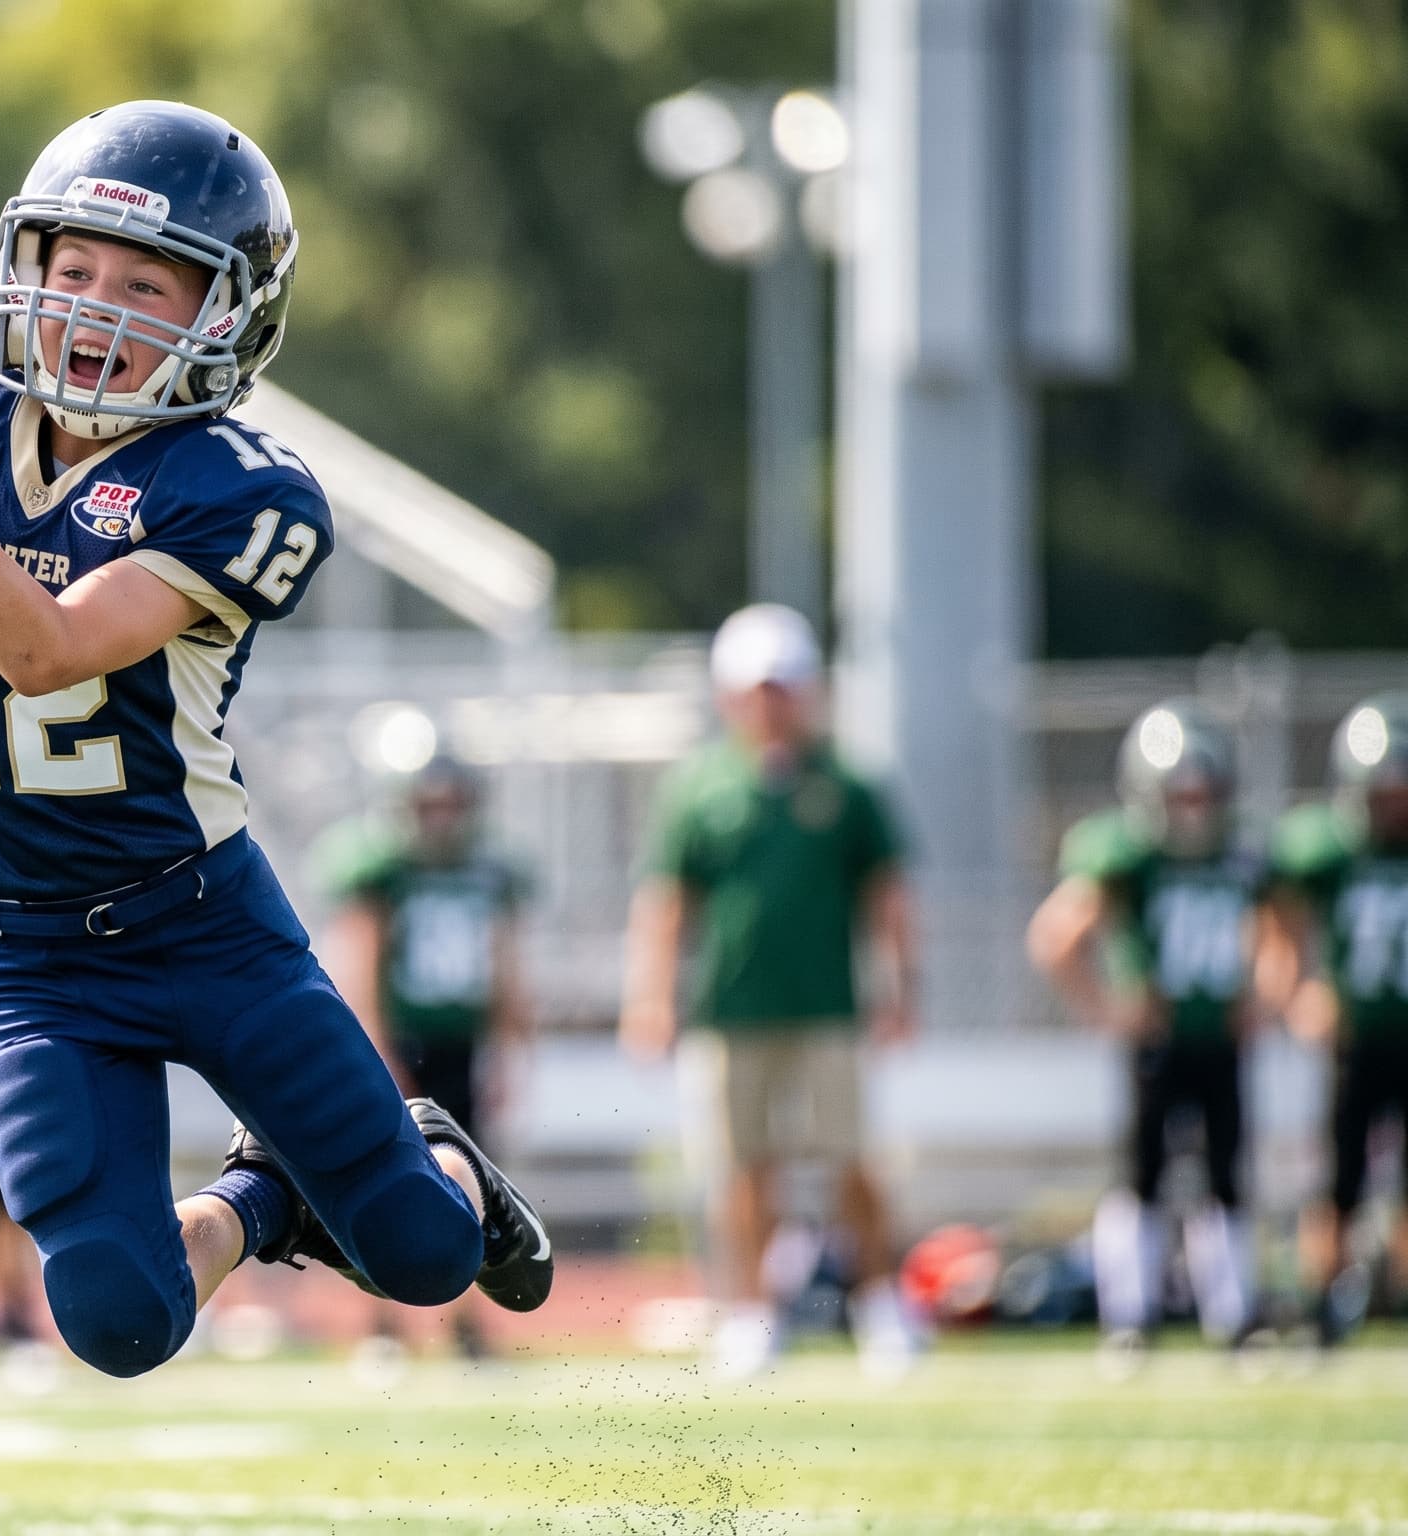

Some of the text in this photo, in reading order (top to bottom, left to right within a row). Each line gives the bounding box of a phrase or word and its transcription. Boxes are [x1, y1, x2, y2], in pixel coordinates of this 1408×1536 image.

[206, 424, 312, 479] 12
[95, 485, 137, 502] POP
[222, 508, 317, 606] 12
